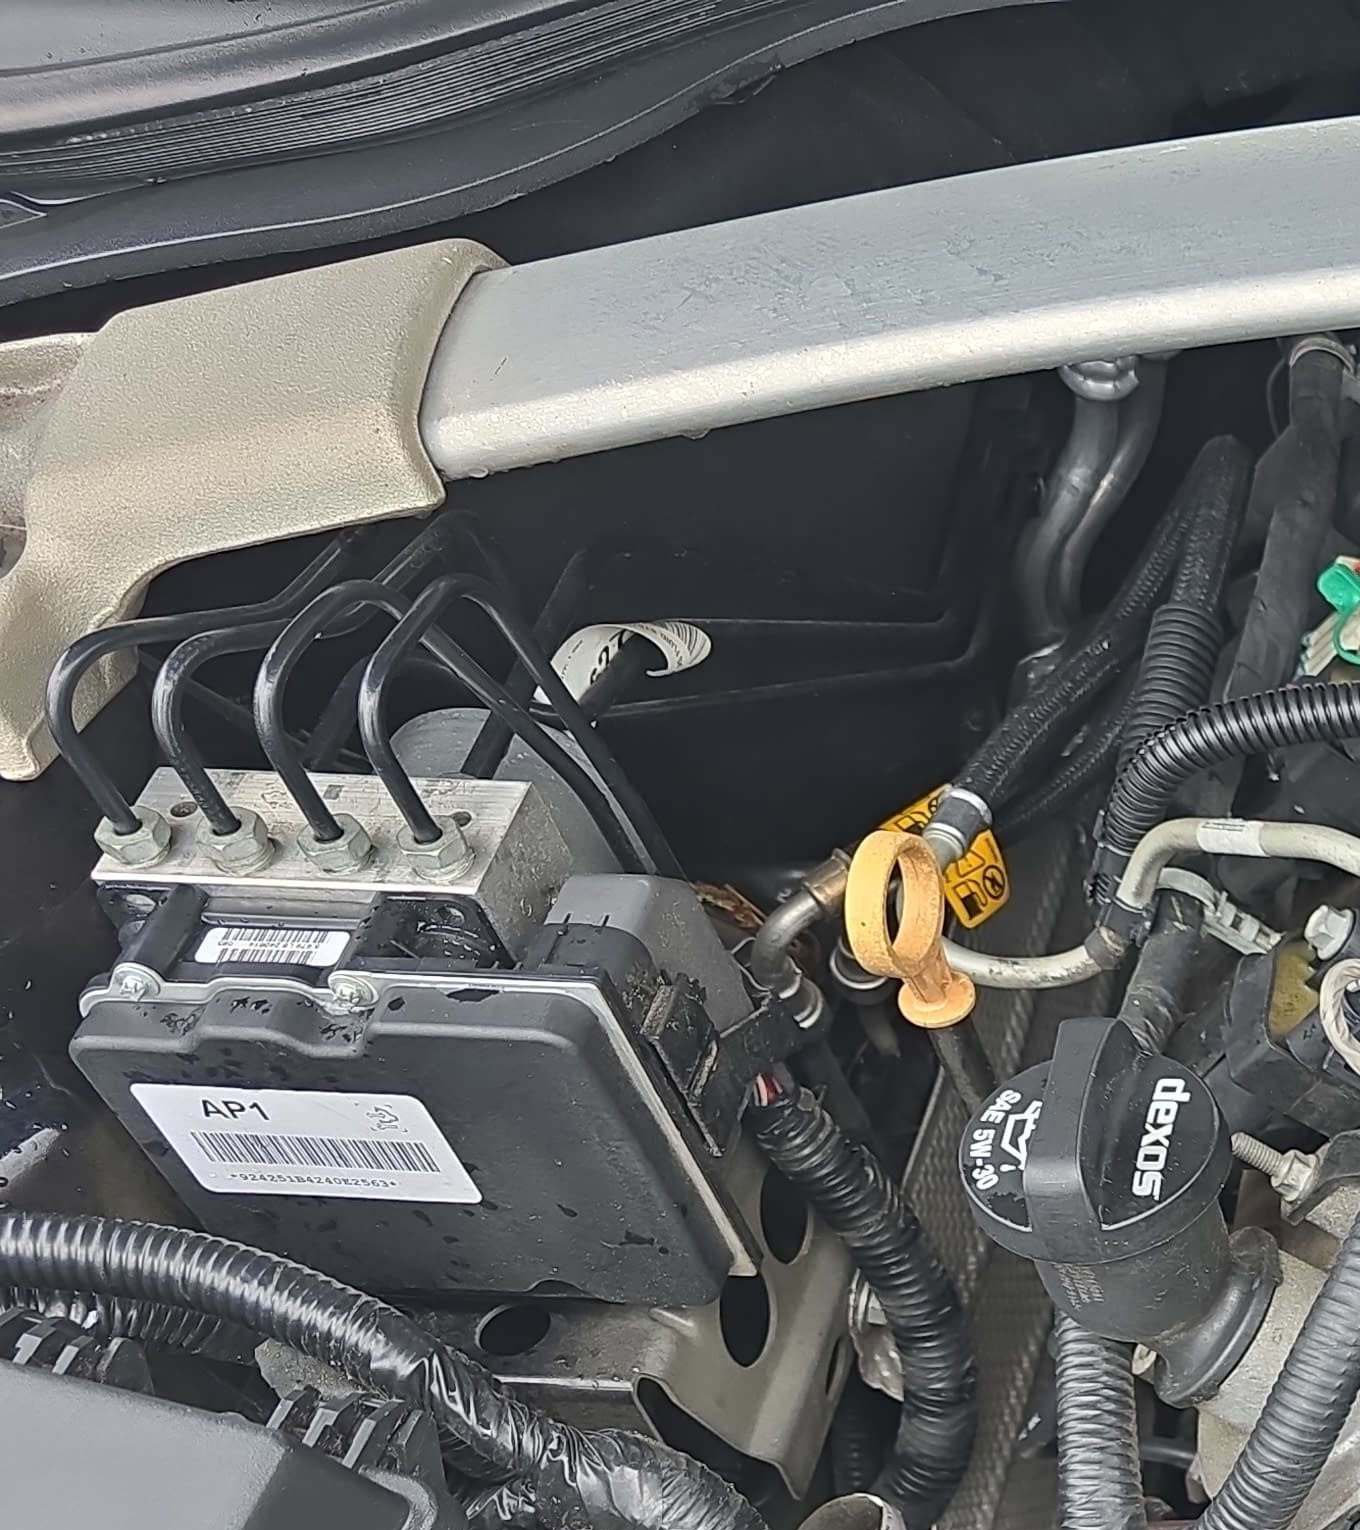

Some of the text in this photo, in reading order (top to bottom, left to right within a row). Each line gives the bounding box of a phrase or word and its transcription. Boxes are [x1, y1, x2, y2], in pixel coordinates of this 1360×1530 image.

[201, 1098, 271, 1121] AP1
[969, 1089, 1022, 1191] SAE 5W-30
[1131, 1077, 1191, 1201] dexos
